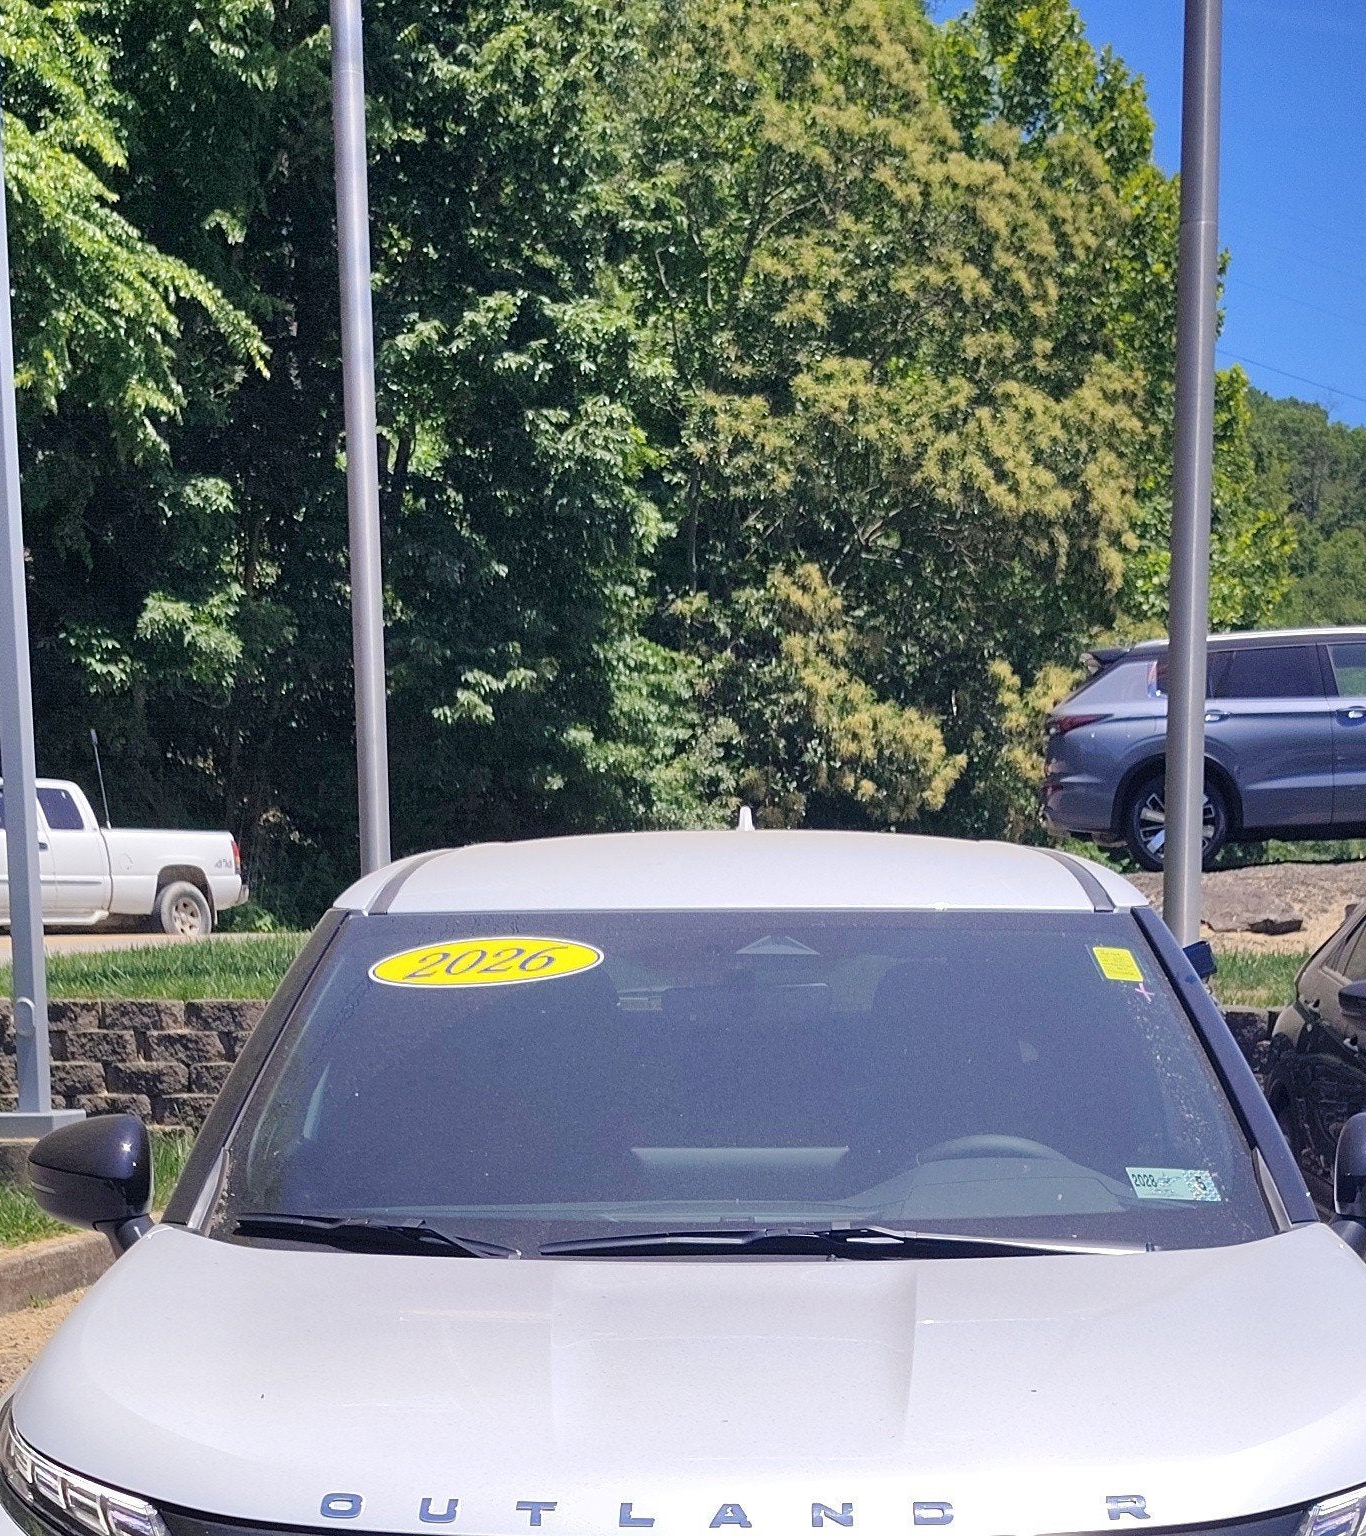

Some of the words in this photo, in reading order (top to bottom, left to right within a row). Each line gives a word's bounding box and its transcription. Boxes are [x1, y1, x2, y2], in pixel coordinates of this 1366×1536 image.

[402, 944, 569, 981] 2026
[1131, 1173, 1158, 1188] 2028
[319, 1491, 1151, 1529] OUTLANDR
